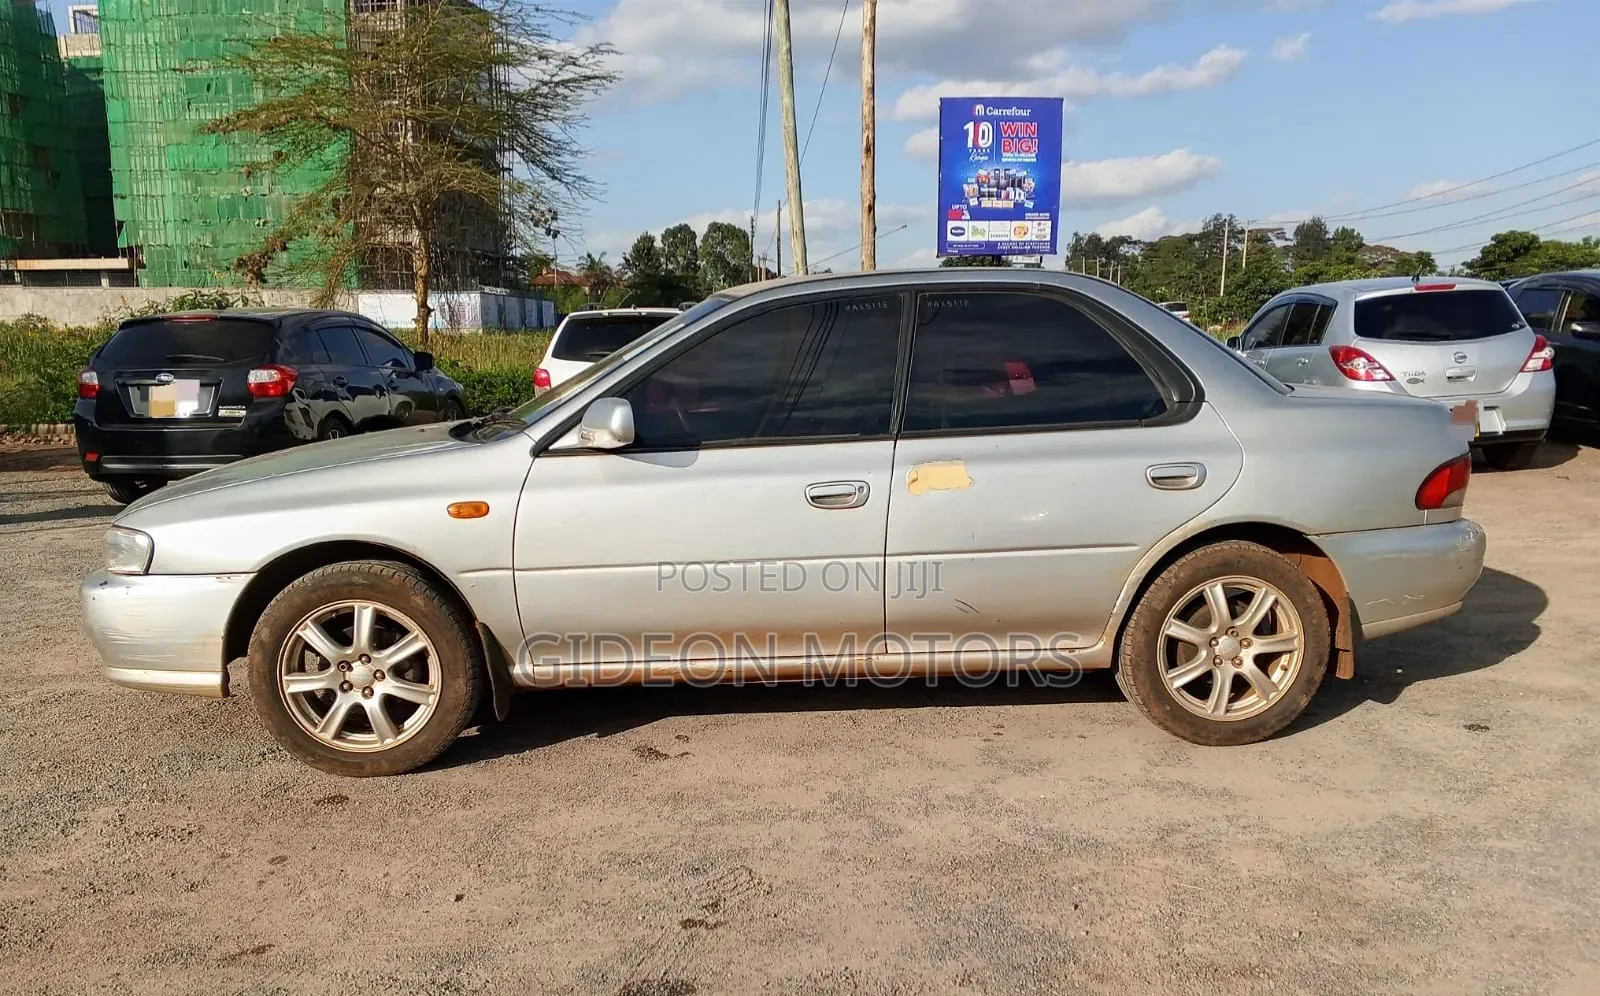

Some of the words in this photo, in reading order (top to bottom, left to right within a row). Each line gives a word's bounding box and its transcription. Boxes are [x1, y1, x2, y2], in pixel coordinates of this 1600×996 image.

[986, 106, 1031, 117] Carrefour
[963, 121, 993, 148] 10
[1000, 121, 1038, 138] WIN
[1001, 138, 1039, 154] BIG!
